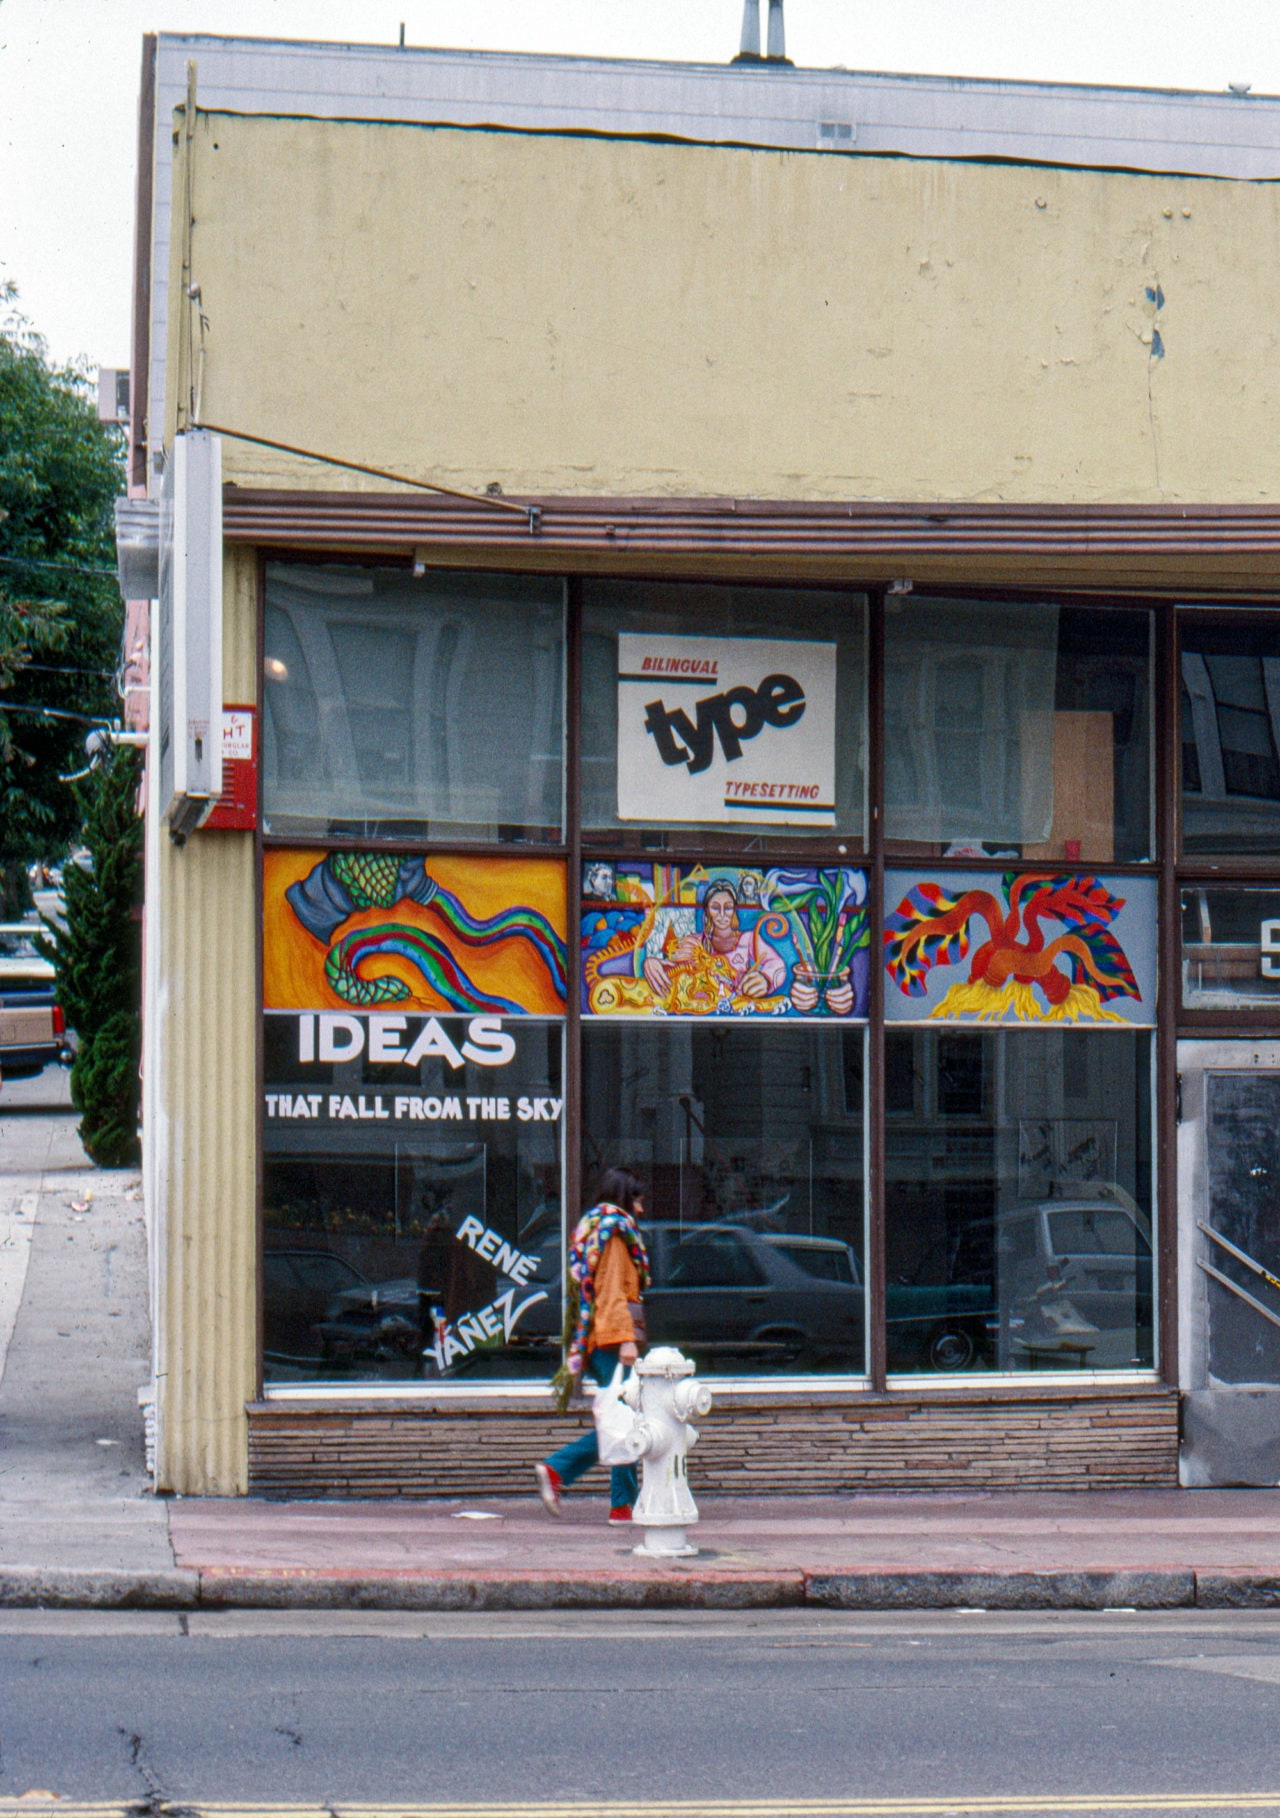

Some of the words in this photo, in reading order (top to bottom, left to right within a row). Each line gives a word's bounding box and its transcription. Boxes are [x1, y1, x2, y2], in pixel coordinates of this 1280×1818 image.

[641, 656, 719, 675] BILINGUAL
[644, 673, 806, 776] type
[725, 780, 820, 798] TYPESETTING
[299, 1014, 516, 1069] IDEAS
[265, 1094, 322, 1119] THAT
[328, 1094, 390, 1119] FALL
[394, 1095, 463, 1120] FROM
[466, 1097, 511, 1120] THE
[516, 1097, 564, 1121] SKY
[456, 1213, 542, 1287] RENÉ
